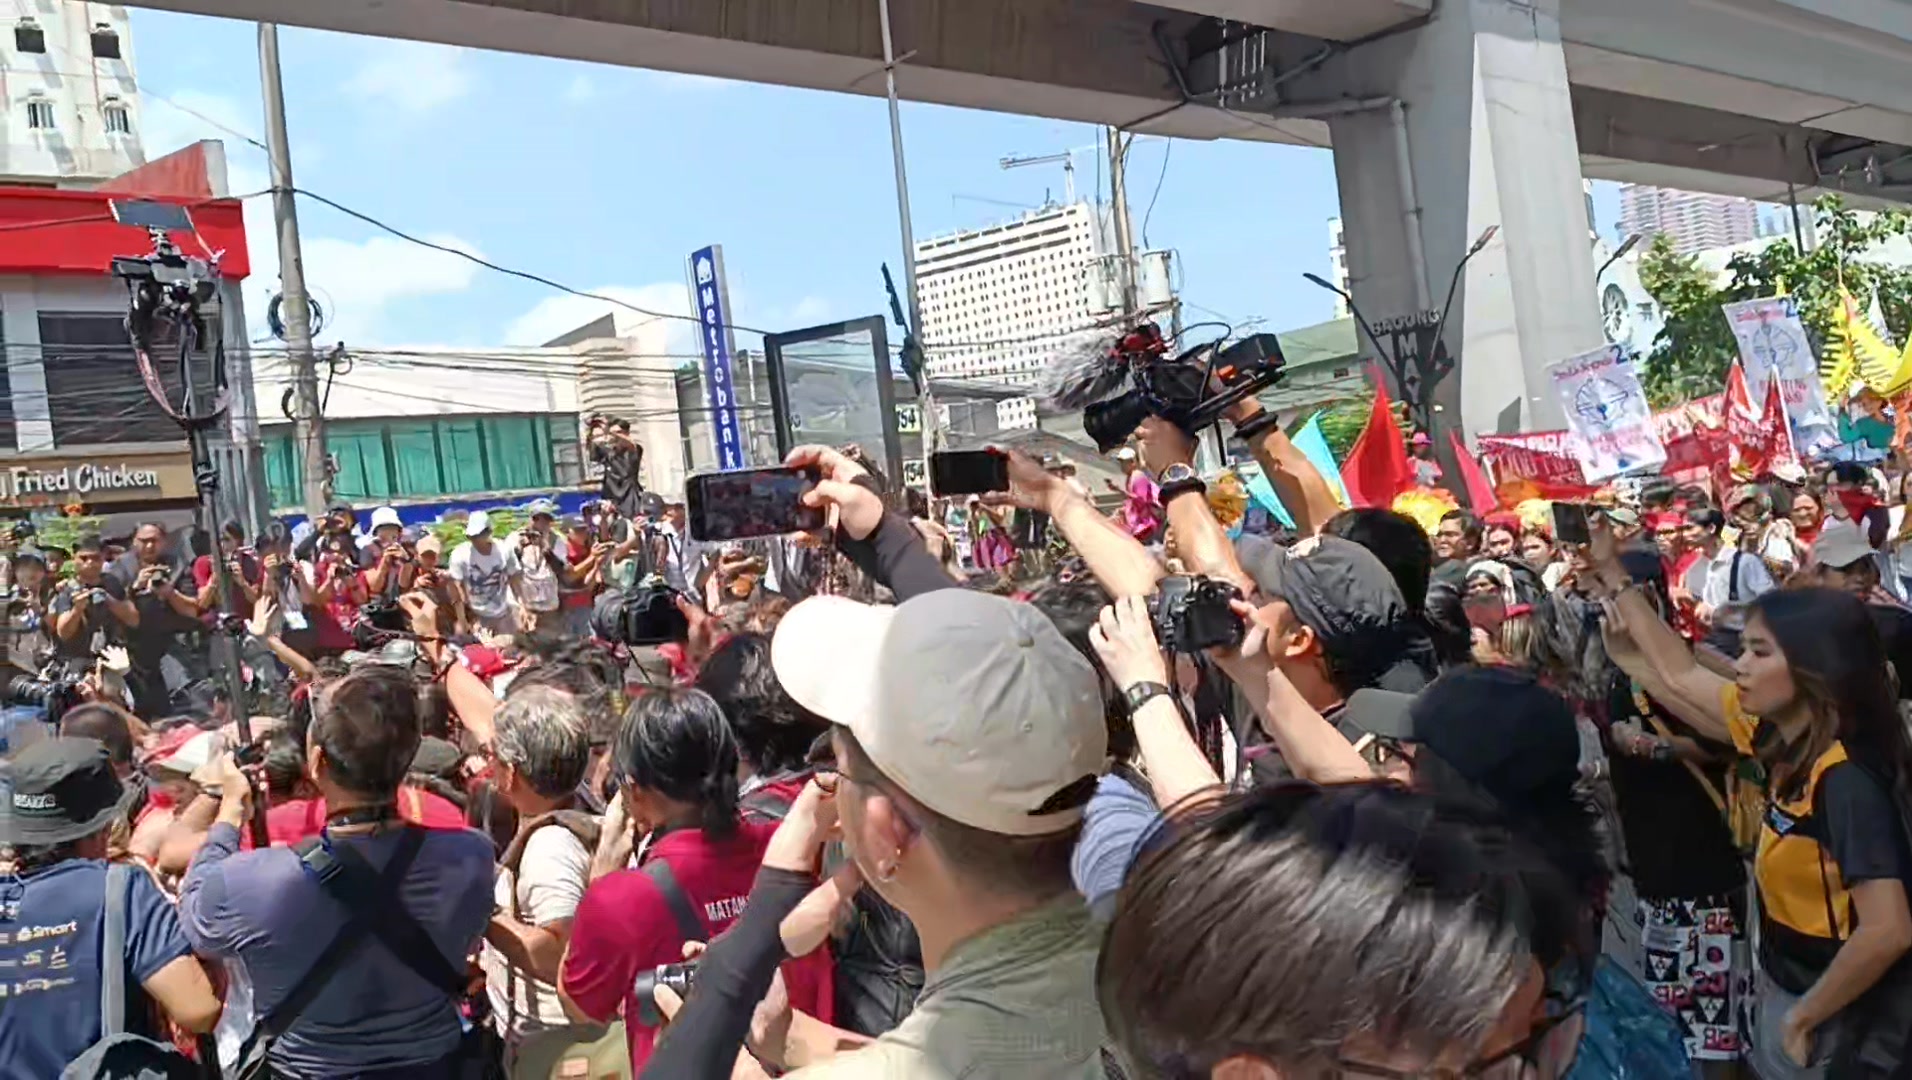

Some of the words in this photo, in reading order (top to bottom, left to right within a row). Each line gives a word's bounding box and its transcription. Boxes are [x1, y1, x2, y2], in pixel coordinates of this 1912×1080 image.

[701, 286, 736, 470] Metrobank
[10, 466, 69, 496] Fried
[74, 462, 158, 493] Chicken
[704, 895, 750, 921] MATAM
